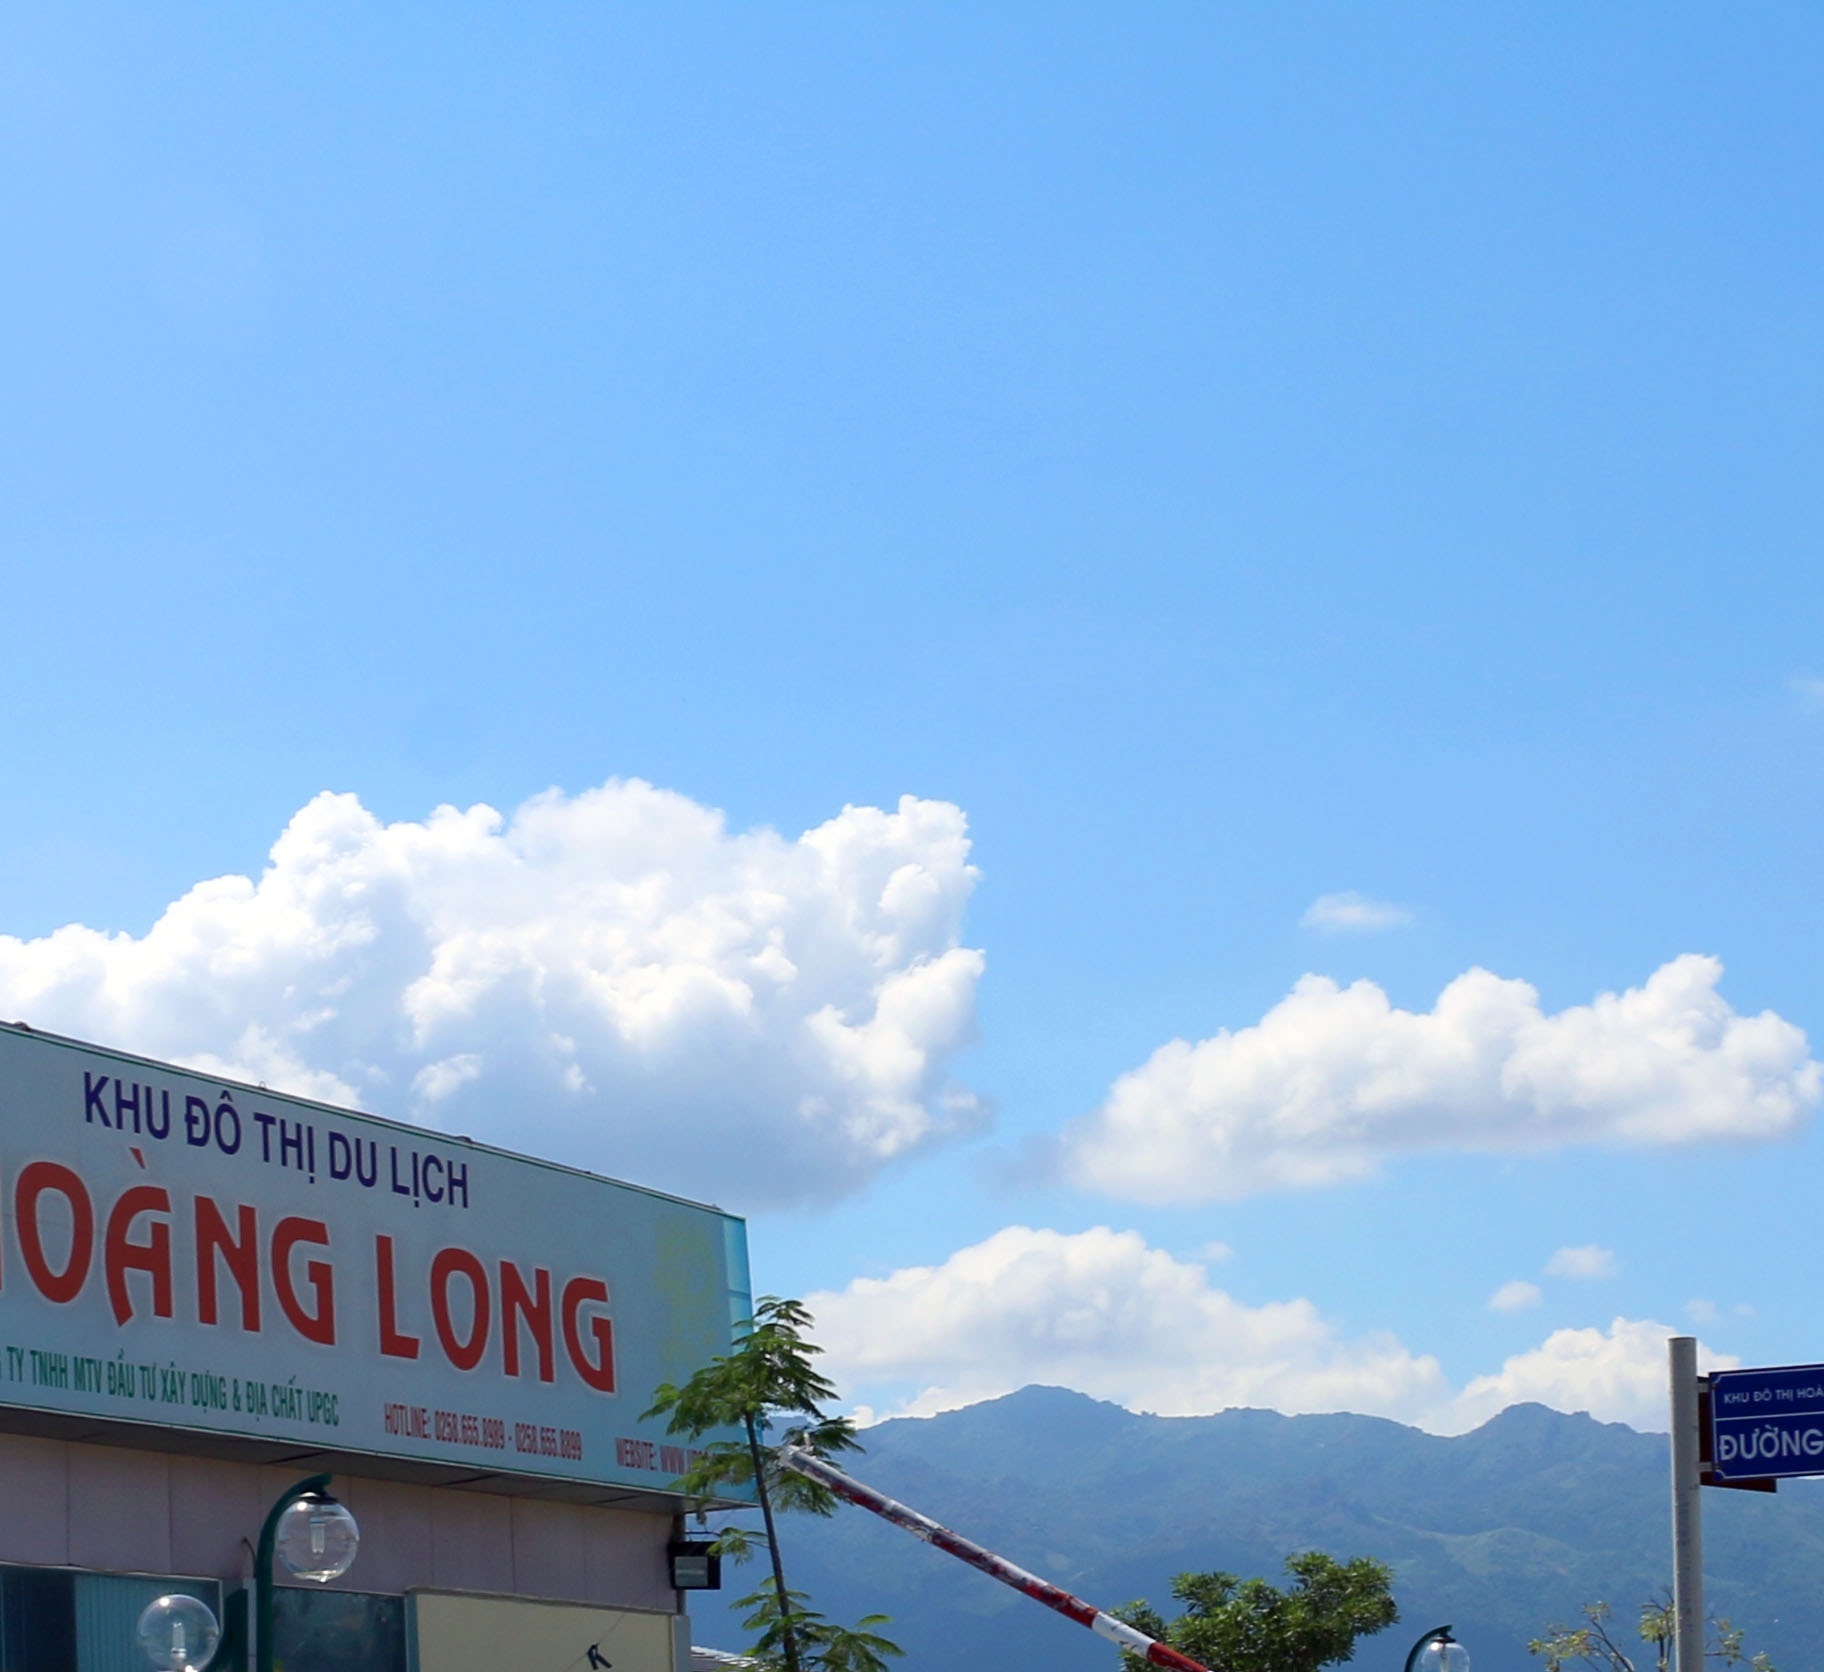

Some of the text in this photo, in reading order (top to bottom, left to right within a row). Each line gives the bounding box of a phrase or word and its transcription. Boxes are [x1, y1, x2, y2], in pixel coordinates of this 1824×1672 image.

[84, 1071, 469, 1209] KHU ĐÔ THỊ DU LỊCH
[376, 1234, 616, 1394] LONG
[7, 1346, 25, 1383] TY
[30, 1350, 69, 1390] TNHH
[74, 1356, 103, 1394] MTV
[108, 1348, 135, 1398] ĐẦU
[139, 1362, 157, 1401] TƯ
[160, 1361, 186, 1405] XÂY
[233, 1379, 242, 1412] &
[246, 1381, 268, 1422] ĐỊA
[272, 1375, 303, 1421] CHẤT
[307, 1390, 340, 1427] UPGC
[1724, 1391, 1750, 1404] KHU
[1753, 1388, 1773, 1402] ĐÔ
